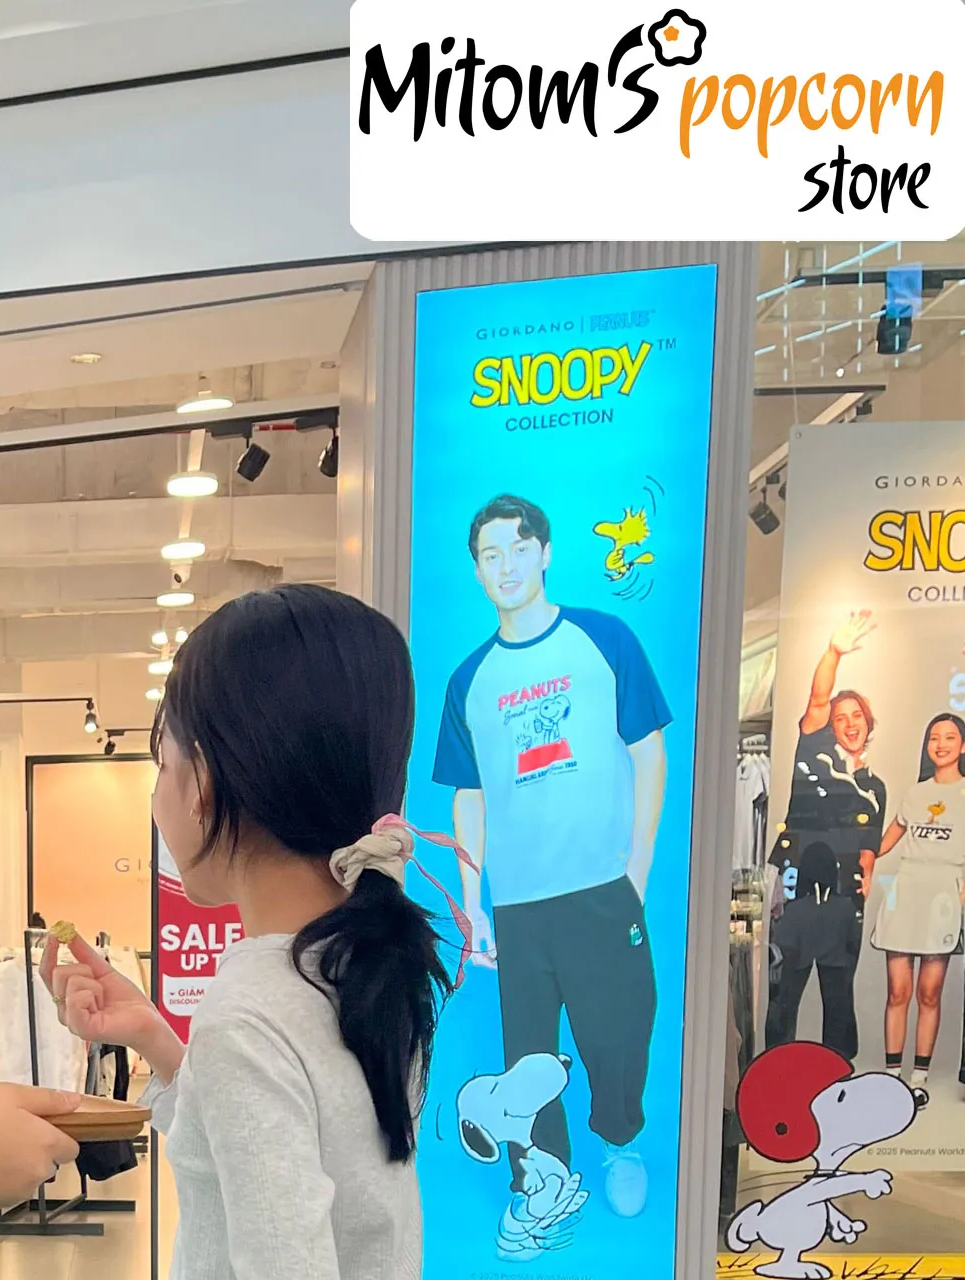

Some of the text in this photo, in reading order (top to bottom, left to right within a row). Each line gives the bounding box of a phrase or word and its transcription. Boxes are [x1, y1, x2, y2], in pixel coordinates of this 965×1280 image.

[476, 320, 575, 340] GIORDANO
[470, 340, 654, 408] SNOOPY
[505, 409, 614, 432] COLLECTION
[875, 475, 963, 489] GIORDA
[907, 585, 965, 602] COLL
[498, 675, 571, 711] PEANUTS
[114, 858, 152, 873] GI
[180, 953, 209, 971] UP
